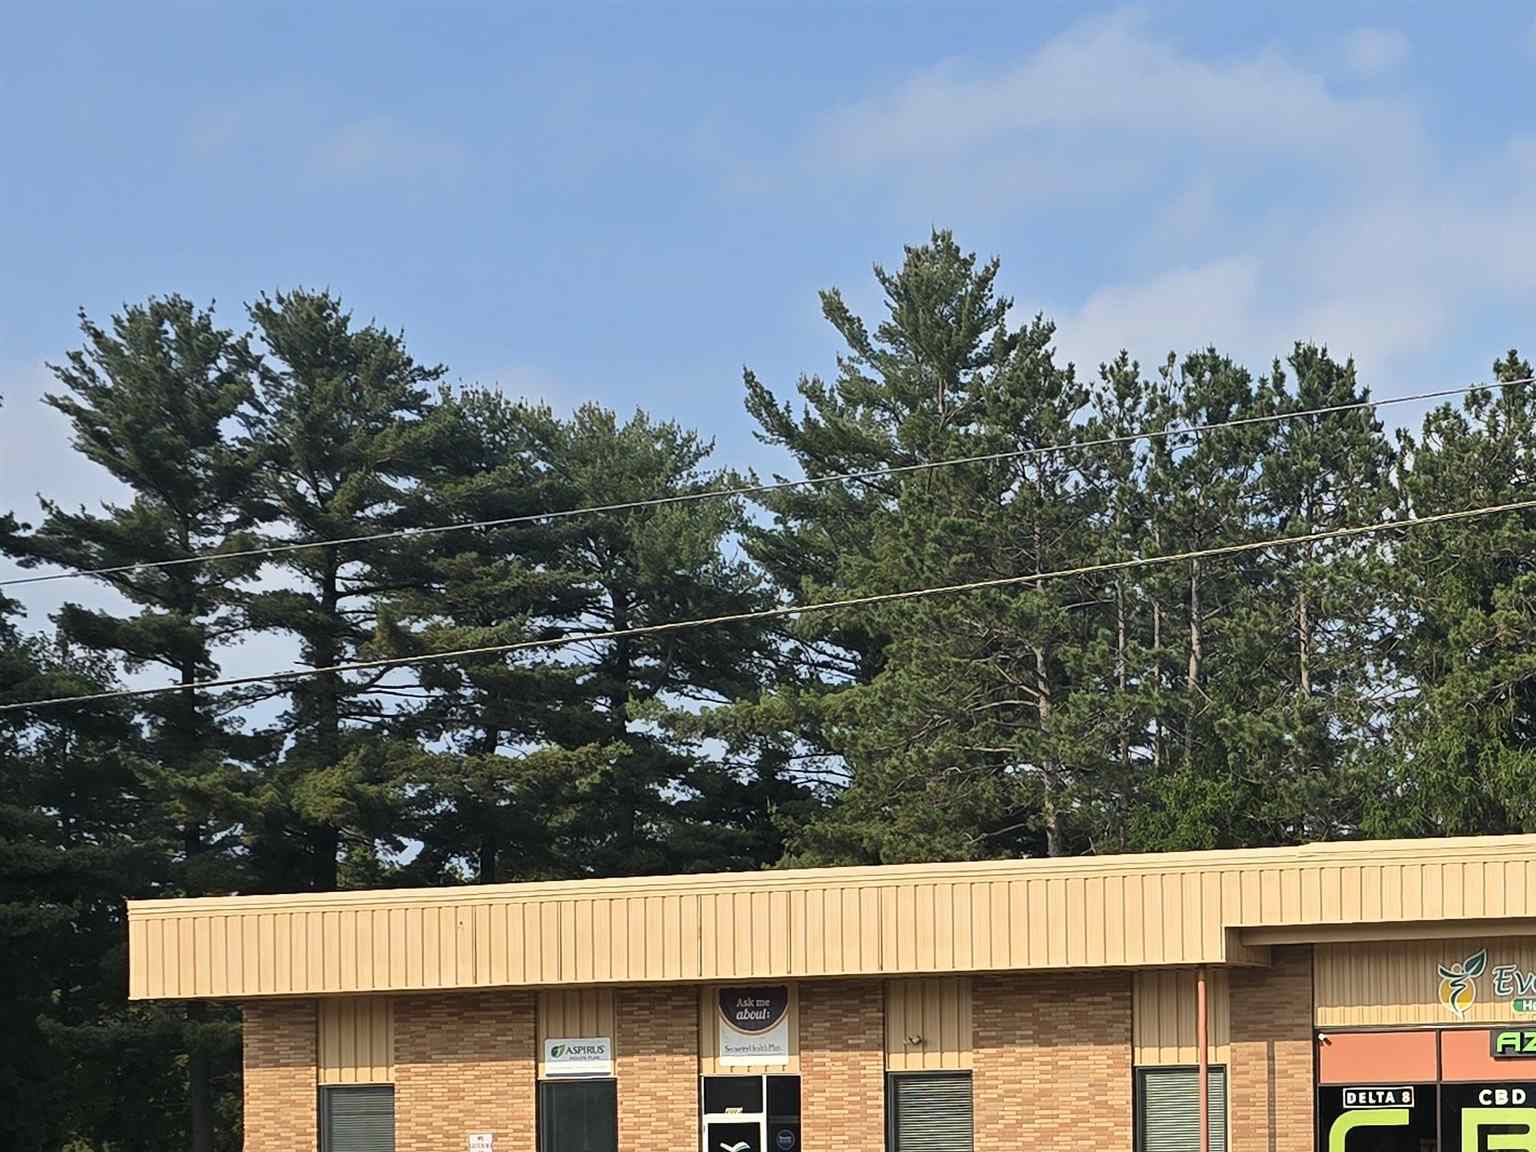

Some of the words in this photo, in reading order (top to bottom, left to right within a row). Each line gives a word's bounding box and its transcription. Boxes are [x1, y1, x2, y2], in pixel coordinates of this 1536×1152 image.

[736, 998, 754, 1007] Ask
[756, 999, 770, 1007] me
[565, 1045, 604, 1055] ASPIRUS
[1346, 1090, 1395, 1104] DELTA
[1401, 1089, 1411, 1103] 8
[1478, 1088, 1526, 1105] CBD
